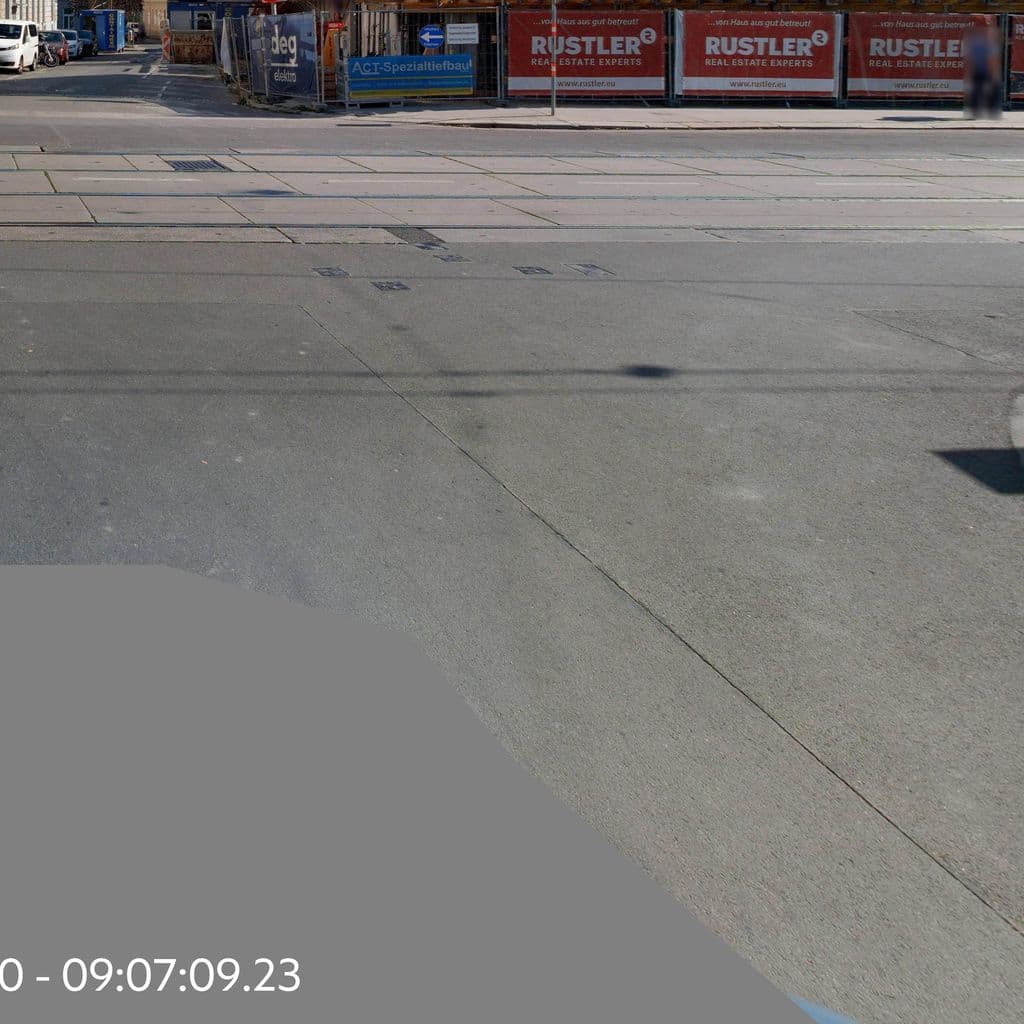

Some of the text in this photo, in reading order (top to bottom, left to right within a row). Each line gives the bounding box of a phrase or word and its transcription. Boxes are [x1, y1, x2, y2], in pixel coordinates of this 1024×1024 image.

[591, 18, 606, 27] gut
[730, 18, 749, 26] Haus
[765, 19, 779, 28] gut
[780, 18, 811, 27] betreut!
[271, 24, 297, 64] deg
[531, 36, 642, 55] RUSTLER
[705, 36, 814, 56] RUSTLER
[869, 37, 964, 57] RUSTLE
[531, 58, 642, 66] REA ESTATE EXPERTS
[705, 58, 814, 68] REAL ESTATE EXPERTS
[868, 59, 964, 69] REAL ESTATE EXPER
[352, 60, 470, 75] ACT-Spezialtiefbau
[273, 69, 297, 83] elektro
[557, 79, 616, 88] www.rustler.eu
[729, 80, 787, 88] www.rustler.eu
[894, 81, 950, 89] www.rustler.eu
